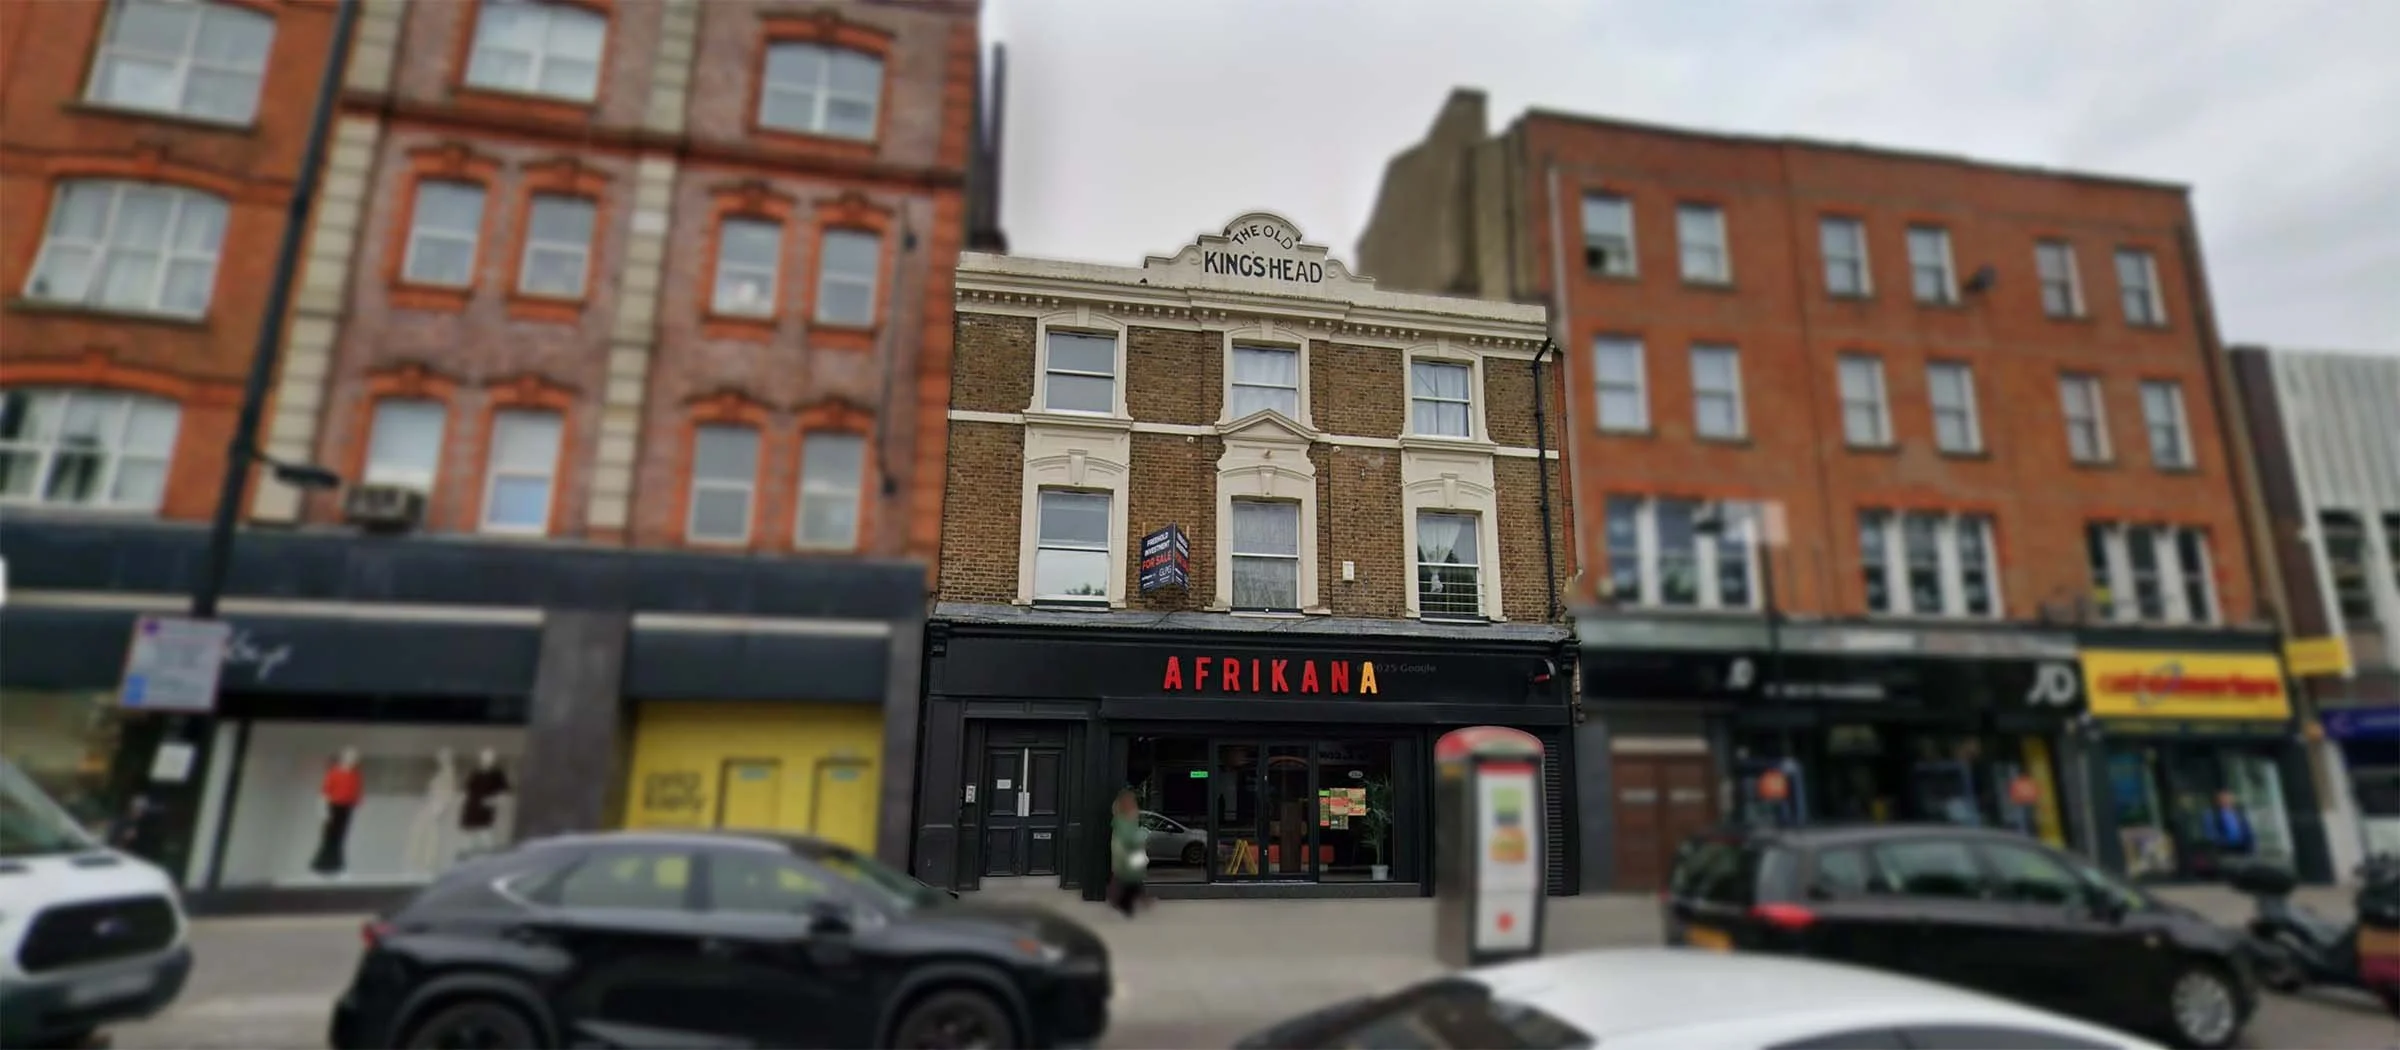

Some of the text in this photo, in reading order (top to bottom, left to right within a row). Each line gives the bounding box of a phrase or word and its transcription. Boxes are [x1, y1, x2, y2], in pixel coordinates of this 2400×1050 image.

[1231, 225, 1293, 250] THE OLD
[1145, 540, 1170, 556] INVESTMENT
[1147, 532, 1168, 546] FREEHOLD
[1142, 558, 1155, 571] FOR
[1155, 550, 1172, 566] SALE
[1164, 656, 1378, 694] AFRIKANA
